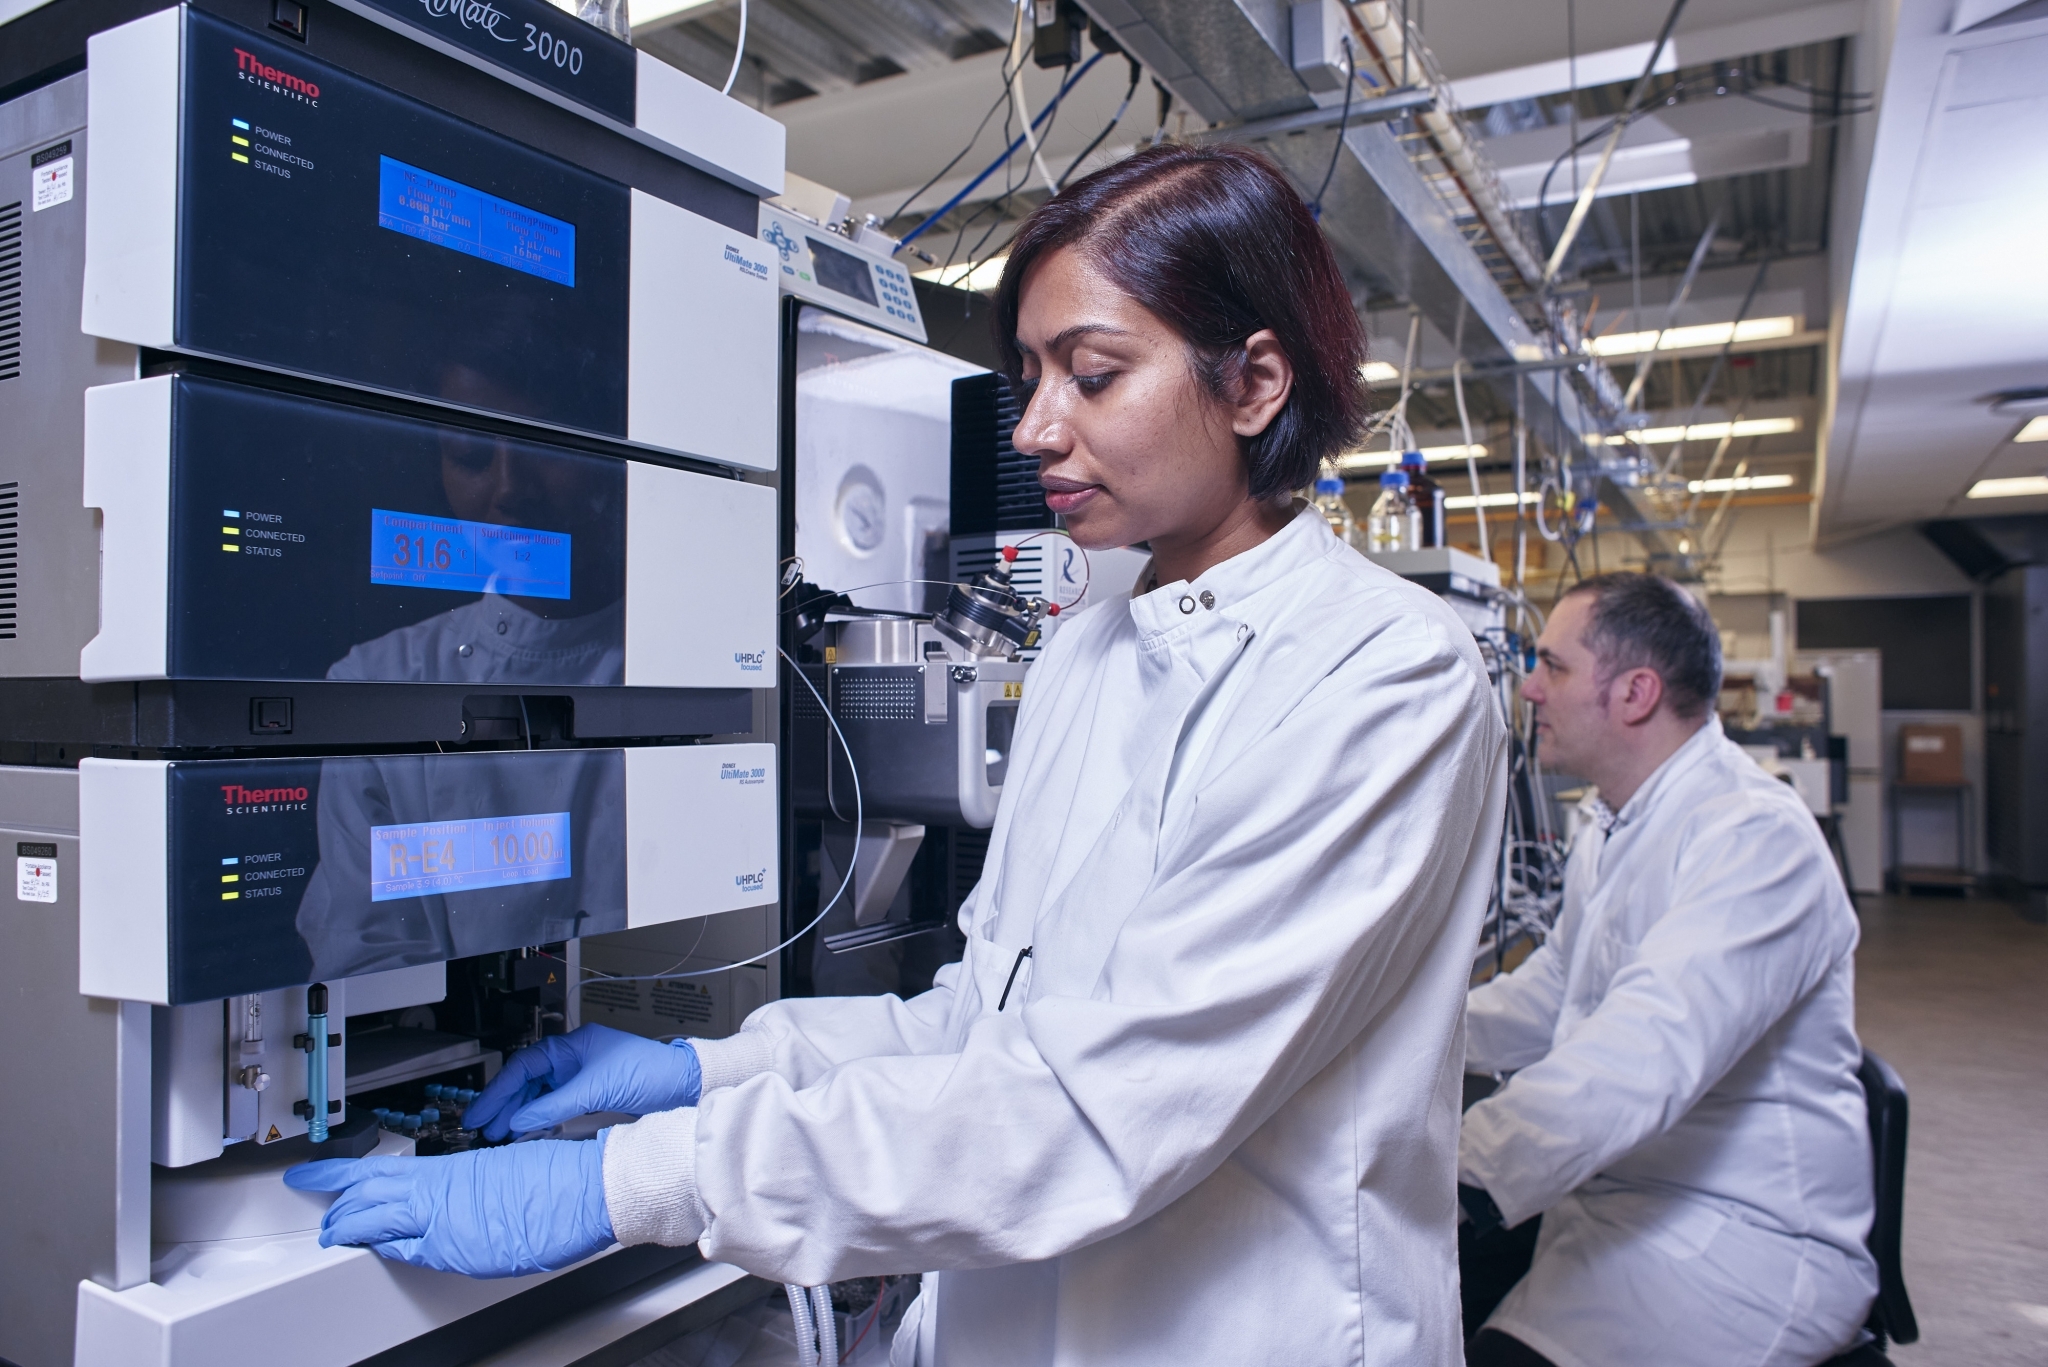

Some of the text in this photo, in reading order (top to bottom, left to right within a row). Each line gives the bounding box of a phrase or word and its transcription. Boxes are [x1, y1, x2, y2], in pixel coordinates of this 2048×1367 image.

[522, 22, 583, 75] 3000
[233, 47, 320, 98] Thermo
[238, 71, 318, 108] SCIENTIFIC
[255, 126, 292, 146] POWER
[36, 145, 67, 165] BS049259
[254, 143, 315, 170] CONNECTED
[254, 160, 291, 179] STATUS
[398, 194, 430, 214] 0.000
[407, 186, 453, 211] Flow On
[432, 217, 450, 232] bar
[493, 203, 559, 235] LoadingPump
[506, 220, 546, 243] Flow On
[513, 245, 543, 262] 16 bar
[724, 250, 752, 269] UltiMate
[753, 262, 768, 275] 3000
[245, 511, 282, 524] POWER
[384, 515, 463, 535] Compartment
[245, 528, 306, 543] CONNECTED
[481, 527, 530, 545] Switching
[245, 545, 282, 558] STATUS
[393, 533, 451, 570] 31.6
[514, 550, 531, 562] 1-2
[413, 573, 426, 582] Off
[741, 663, 762, 671] focused
[721, 768, 765, 780] UltiMate 3000
[221, 785, 308, 805] Thermo
[226, 803, 307, 815] SCIENTIFIC
[376, 824, 467, 841] Sample Position
[483, 817, 555, 832] Inject Volume
[490, 830, 554, 866] 10.00
[244, 852, 282, 864] POWER
[389, 838, 456, 877] R-E4
[244, 867, 305, 881] CONNECTED
[523, 866, 539, 876] Load
[245, 886, 282, 899] STATUS
[385, 881, 415, 893] Sample
[416, 880, 430, 889] 3.9
[742, 883, 763, 892] focused
